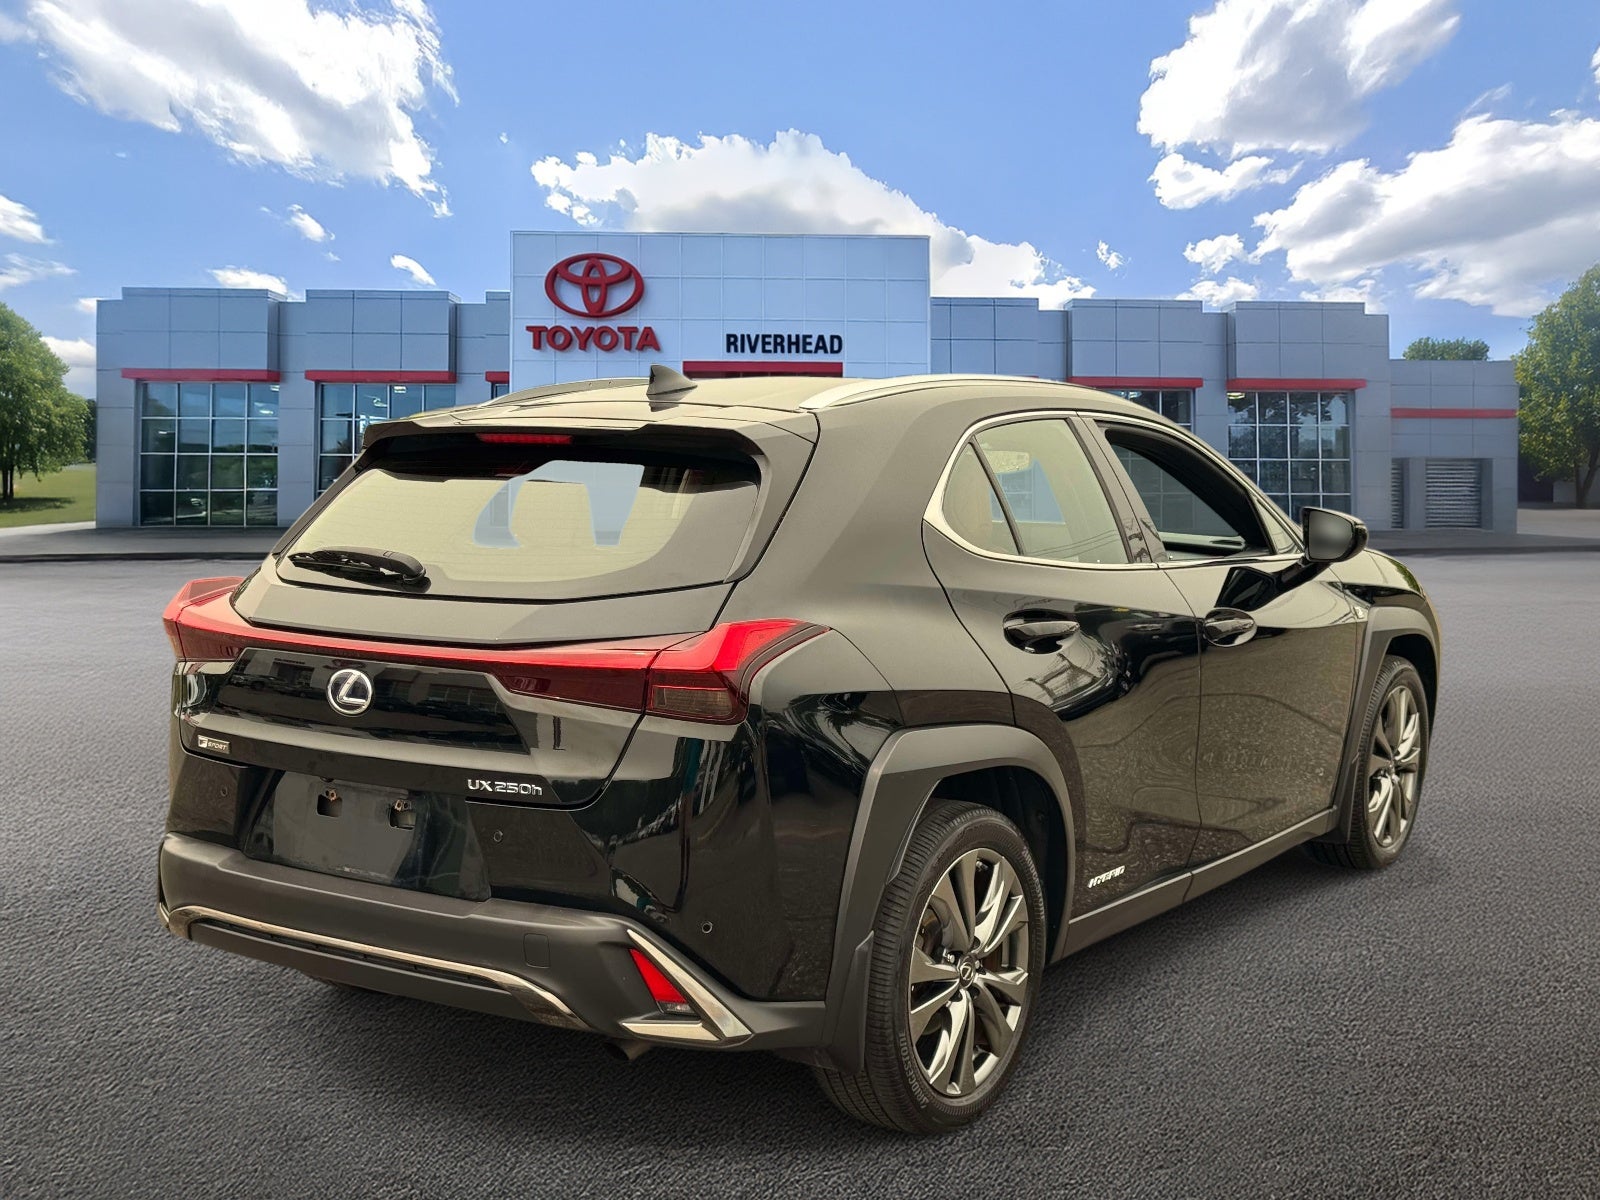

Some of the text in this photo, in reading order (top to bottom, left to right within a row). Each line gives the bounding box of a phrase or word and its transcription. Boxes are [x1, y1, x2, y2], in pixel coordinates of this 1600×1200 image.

[526, 326, 660, 351] TOYOTA
[726, 334, 843, 354] RIVERHEAD
[207, 741, 227, 750] SPORT
[467, 779, 542, 795] UX 250h
